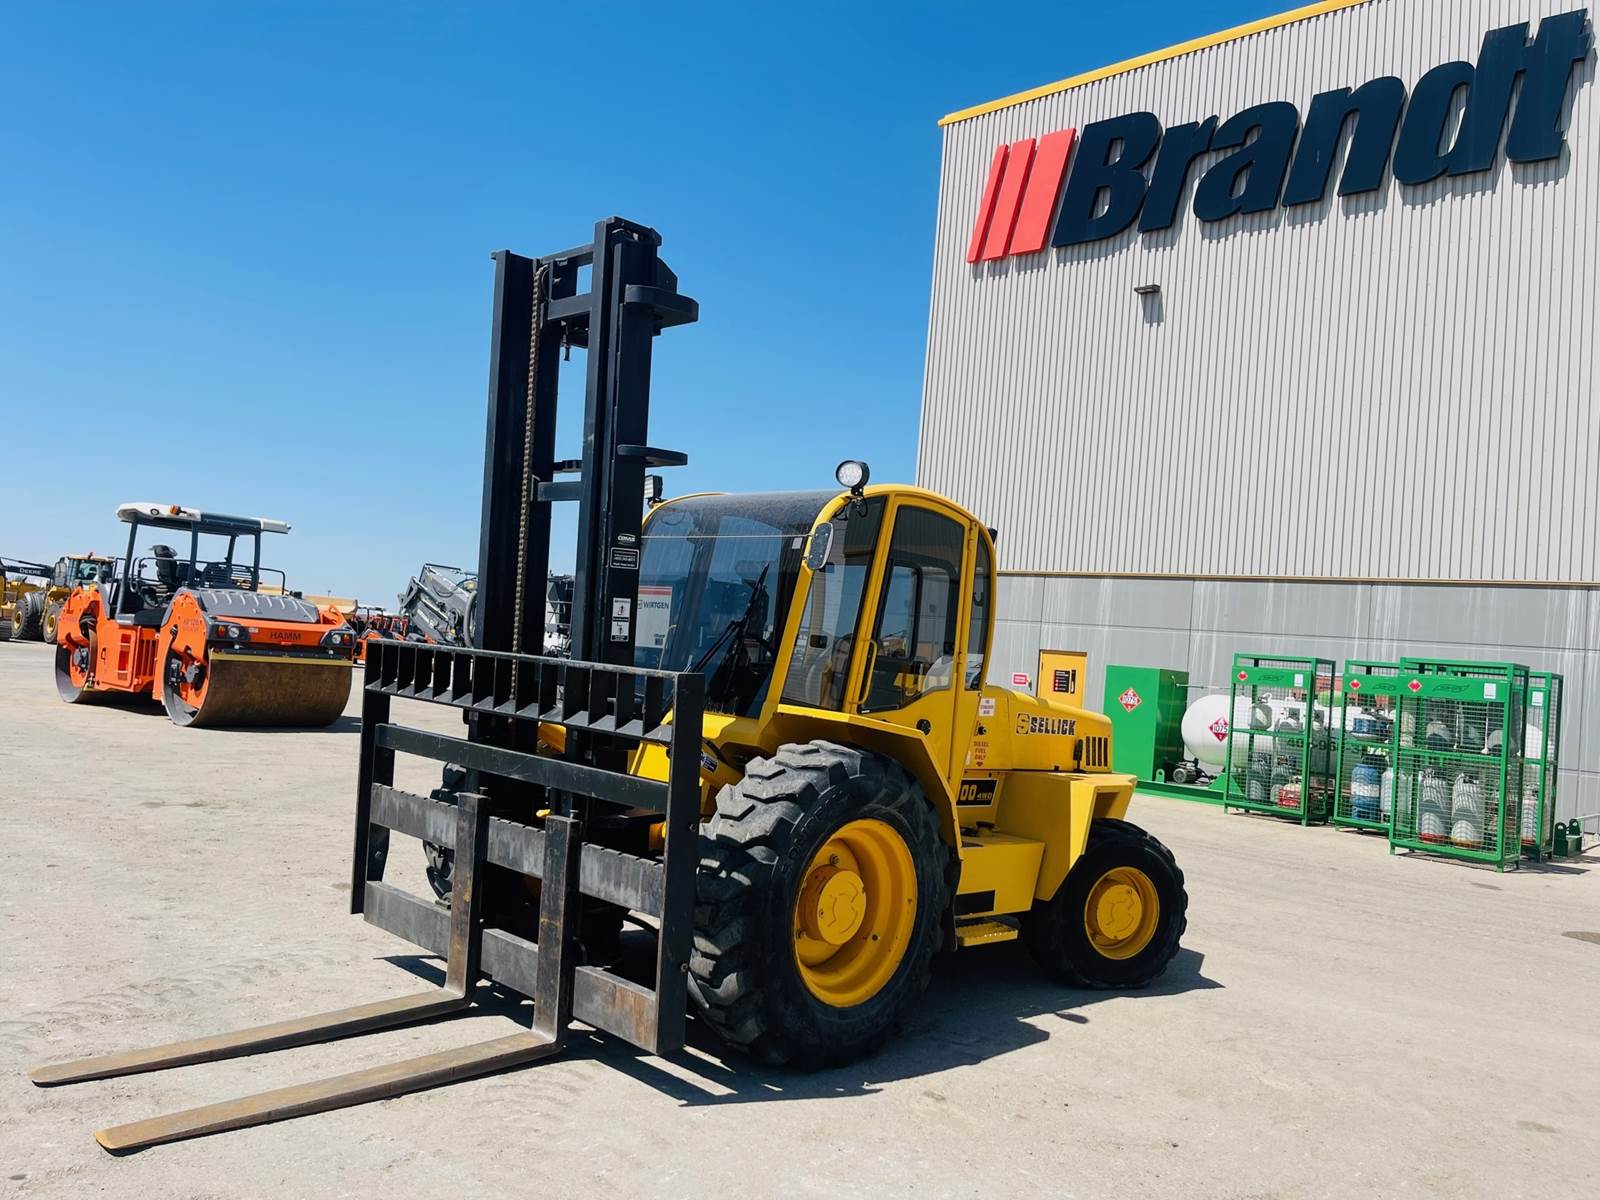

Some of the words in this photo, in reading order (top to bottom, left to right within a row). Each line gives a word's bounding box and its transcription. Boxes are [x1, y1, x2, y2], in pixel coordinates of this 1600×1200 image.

[1052, 8, 1592, 248] Brandt
[20, 567, 41, 576] DEERE
[643, 601, 670, 609] WIRTGEN
[270, 631, 301, 641] HAMM
[1030, 716, 1076, 736] SELLICK
[1213, 724, 1228, 733] 1075
